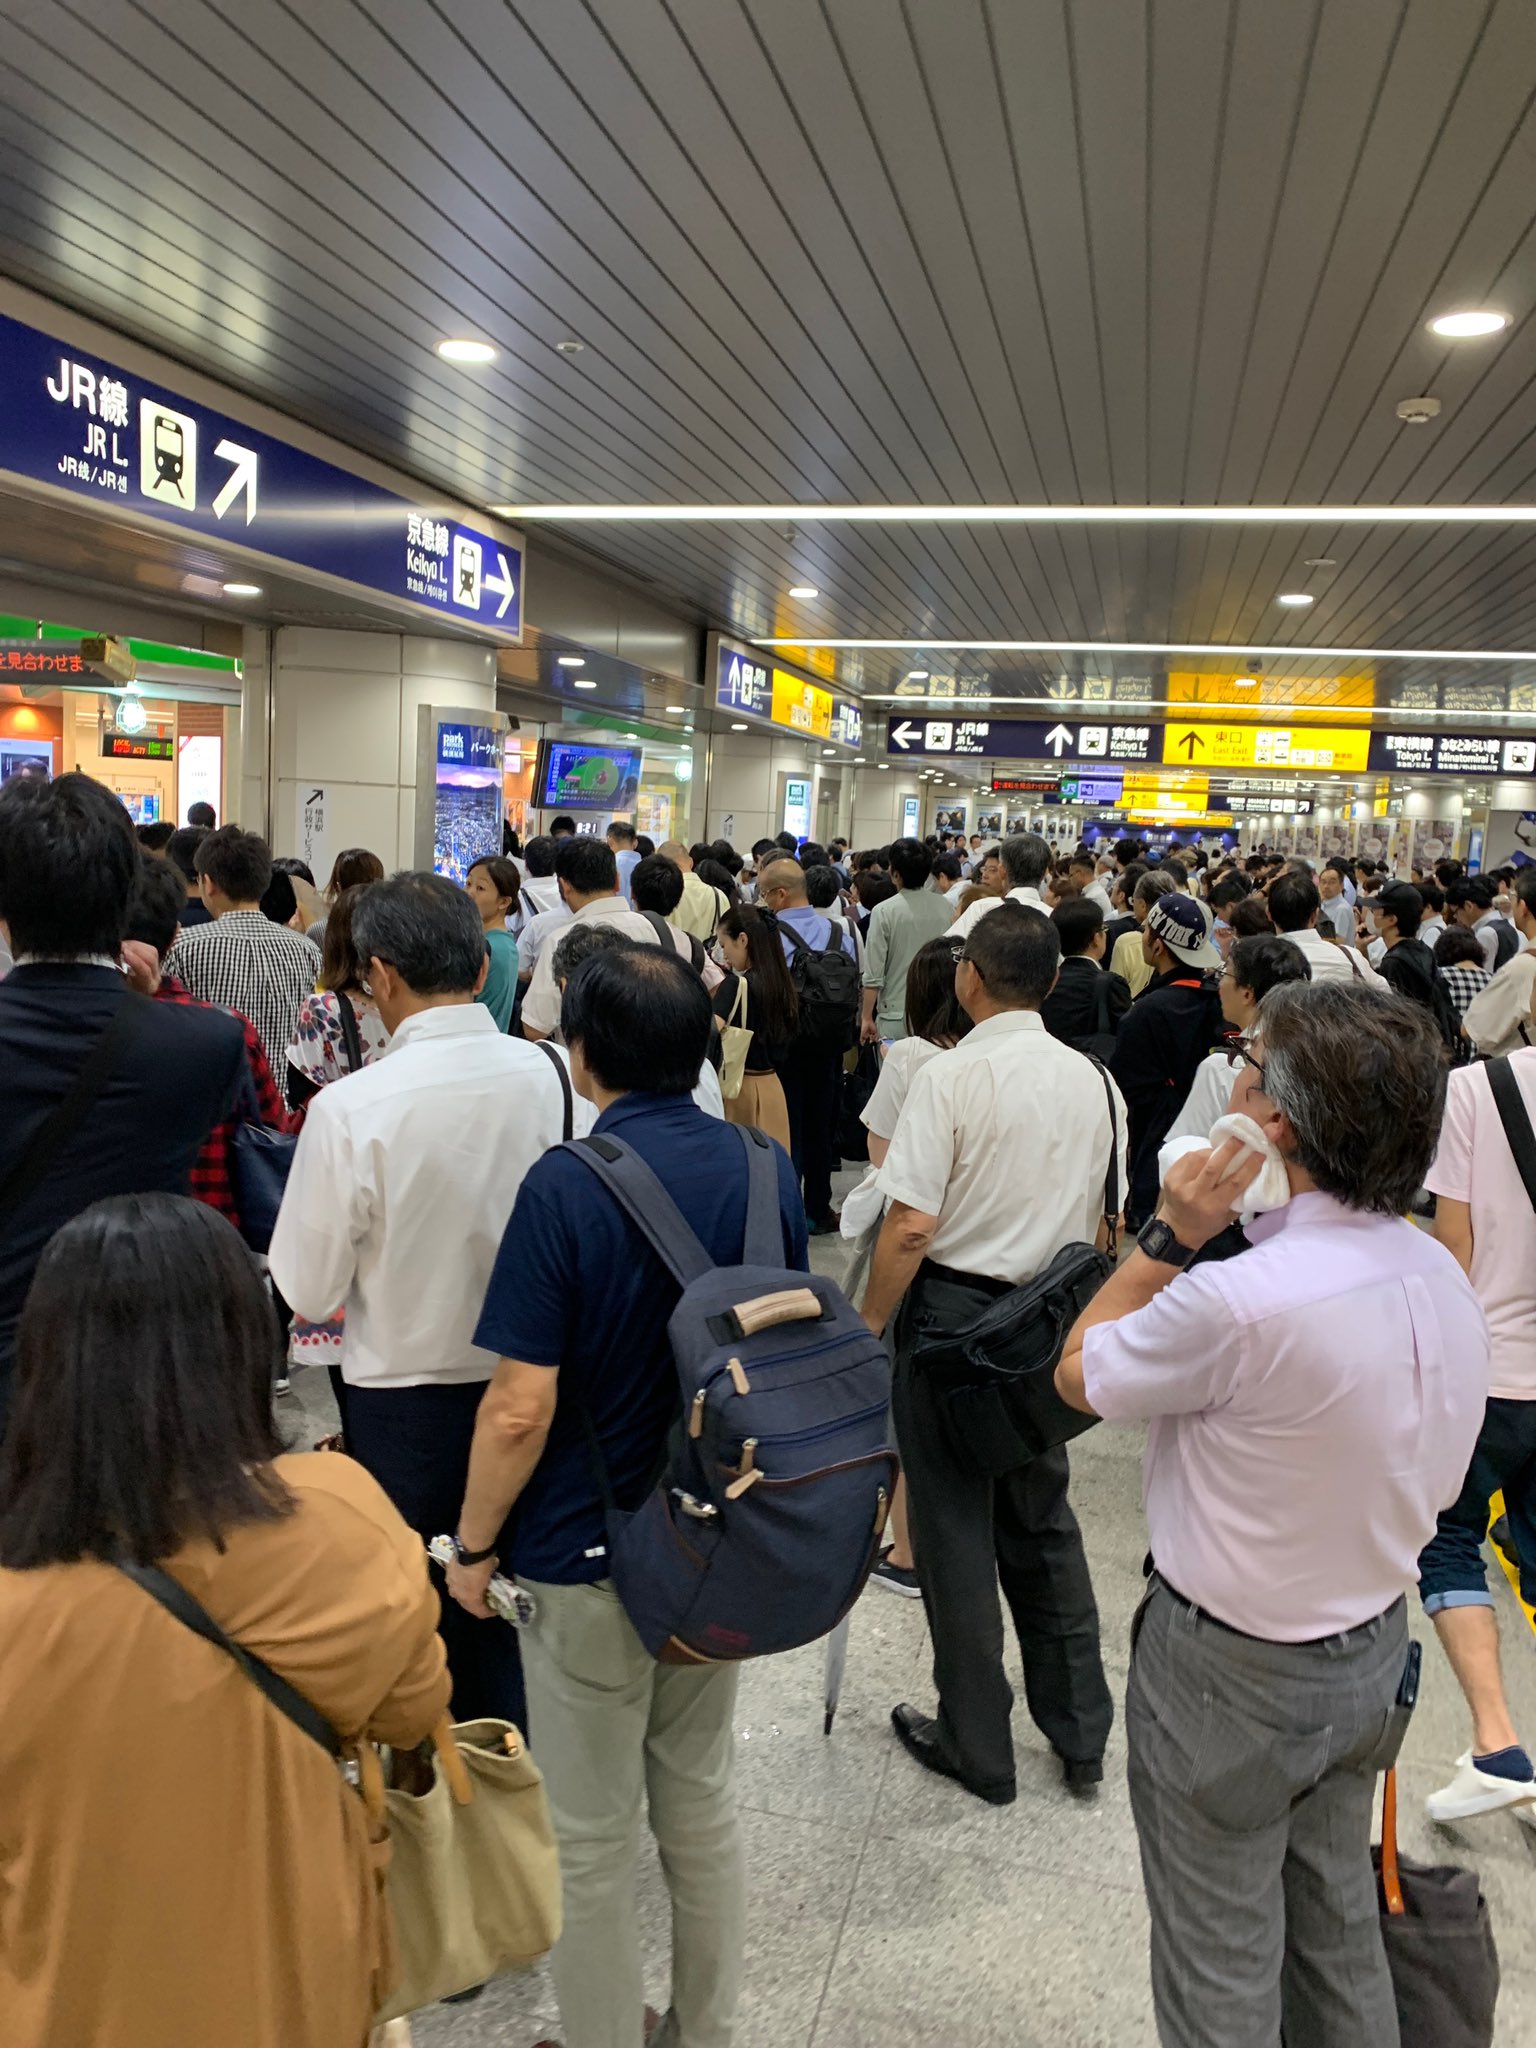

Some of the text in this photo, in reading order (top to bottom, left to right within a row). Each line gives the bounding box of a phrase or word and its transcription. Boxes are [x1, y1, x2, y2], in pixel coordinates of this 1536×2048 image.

[47, 358, 128, 427] JR線
[83, 422, 128, 468] JR L.
[407, 512, 449, 557] 京急線
[440, 561, 448, 584] L.
[0, 651, 84, 673] を見合わせま
[956, 722, 989, 736] JR線
[1111, 727, 1149, 741] 京急線
[955, 735, 966, 745] JR
[1215, 731, 1242, 744] 東口
[1213, 745, 1248, 755] East Exit
[1440, 738, 1500, 754] みなとみらい線
[1437, 752, 1489, 764] Minatomirai
[1061, 783, 1077, 793] JR
[1159, 916, 1195, 947] YORK
